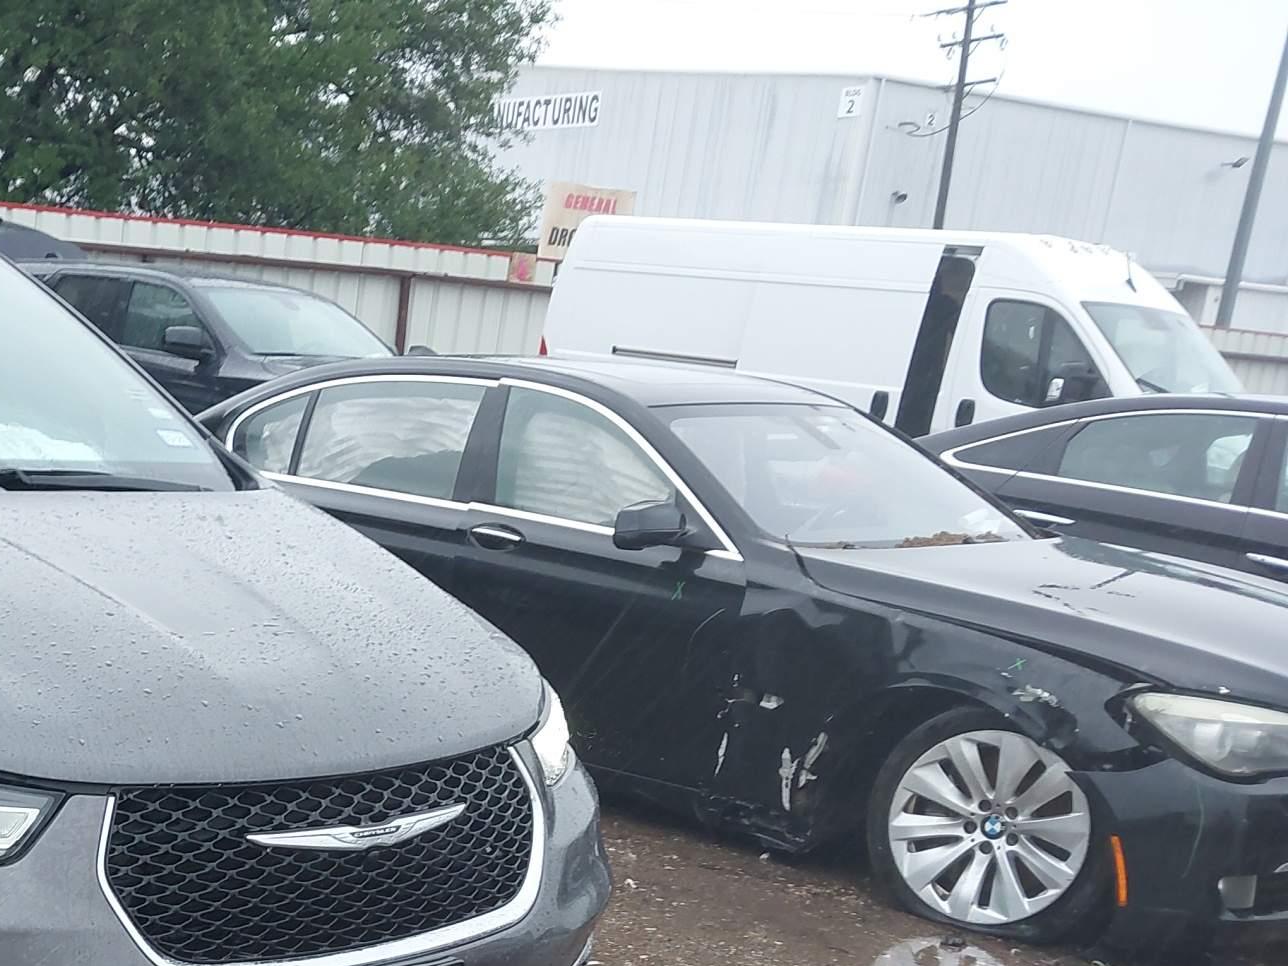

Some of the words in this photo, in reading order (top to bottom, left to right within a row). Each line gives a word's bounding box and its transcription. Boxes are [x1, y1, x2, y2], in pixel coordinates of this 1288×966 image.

[496, 94, 599, 128] NUFACTURING
[846, 99, 855, 114] 2
[927, 114, 935, 126] 2
[564, 193, 617, 214] GENERAL
